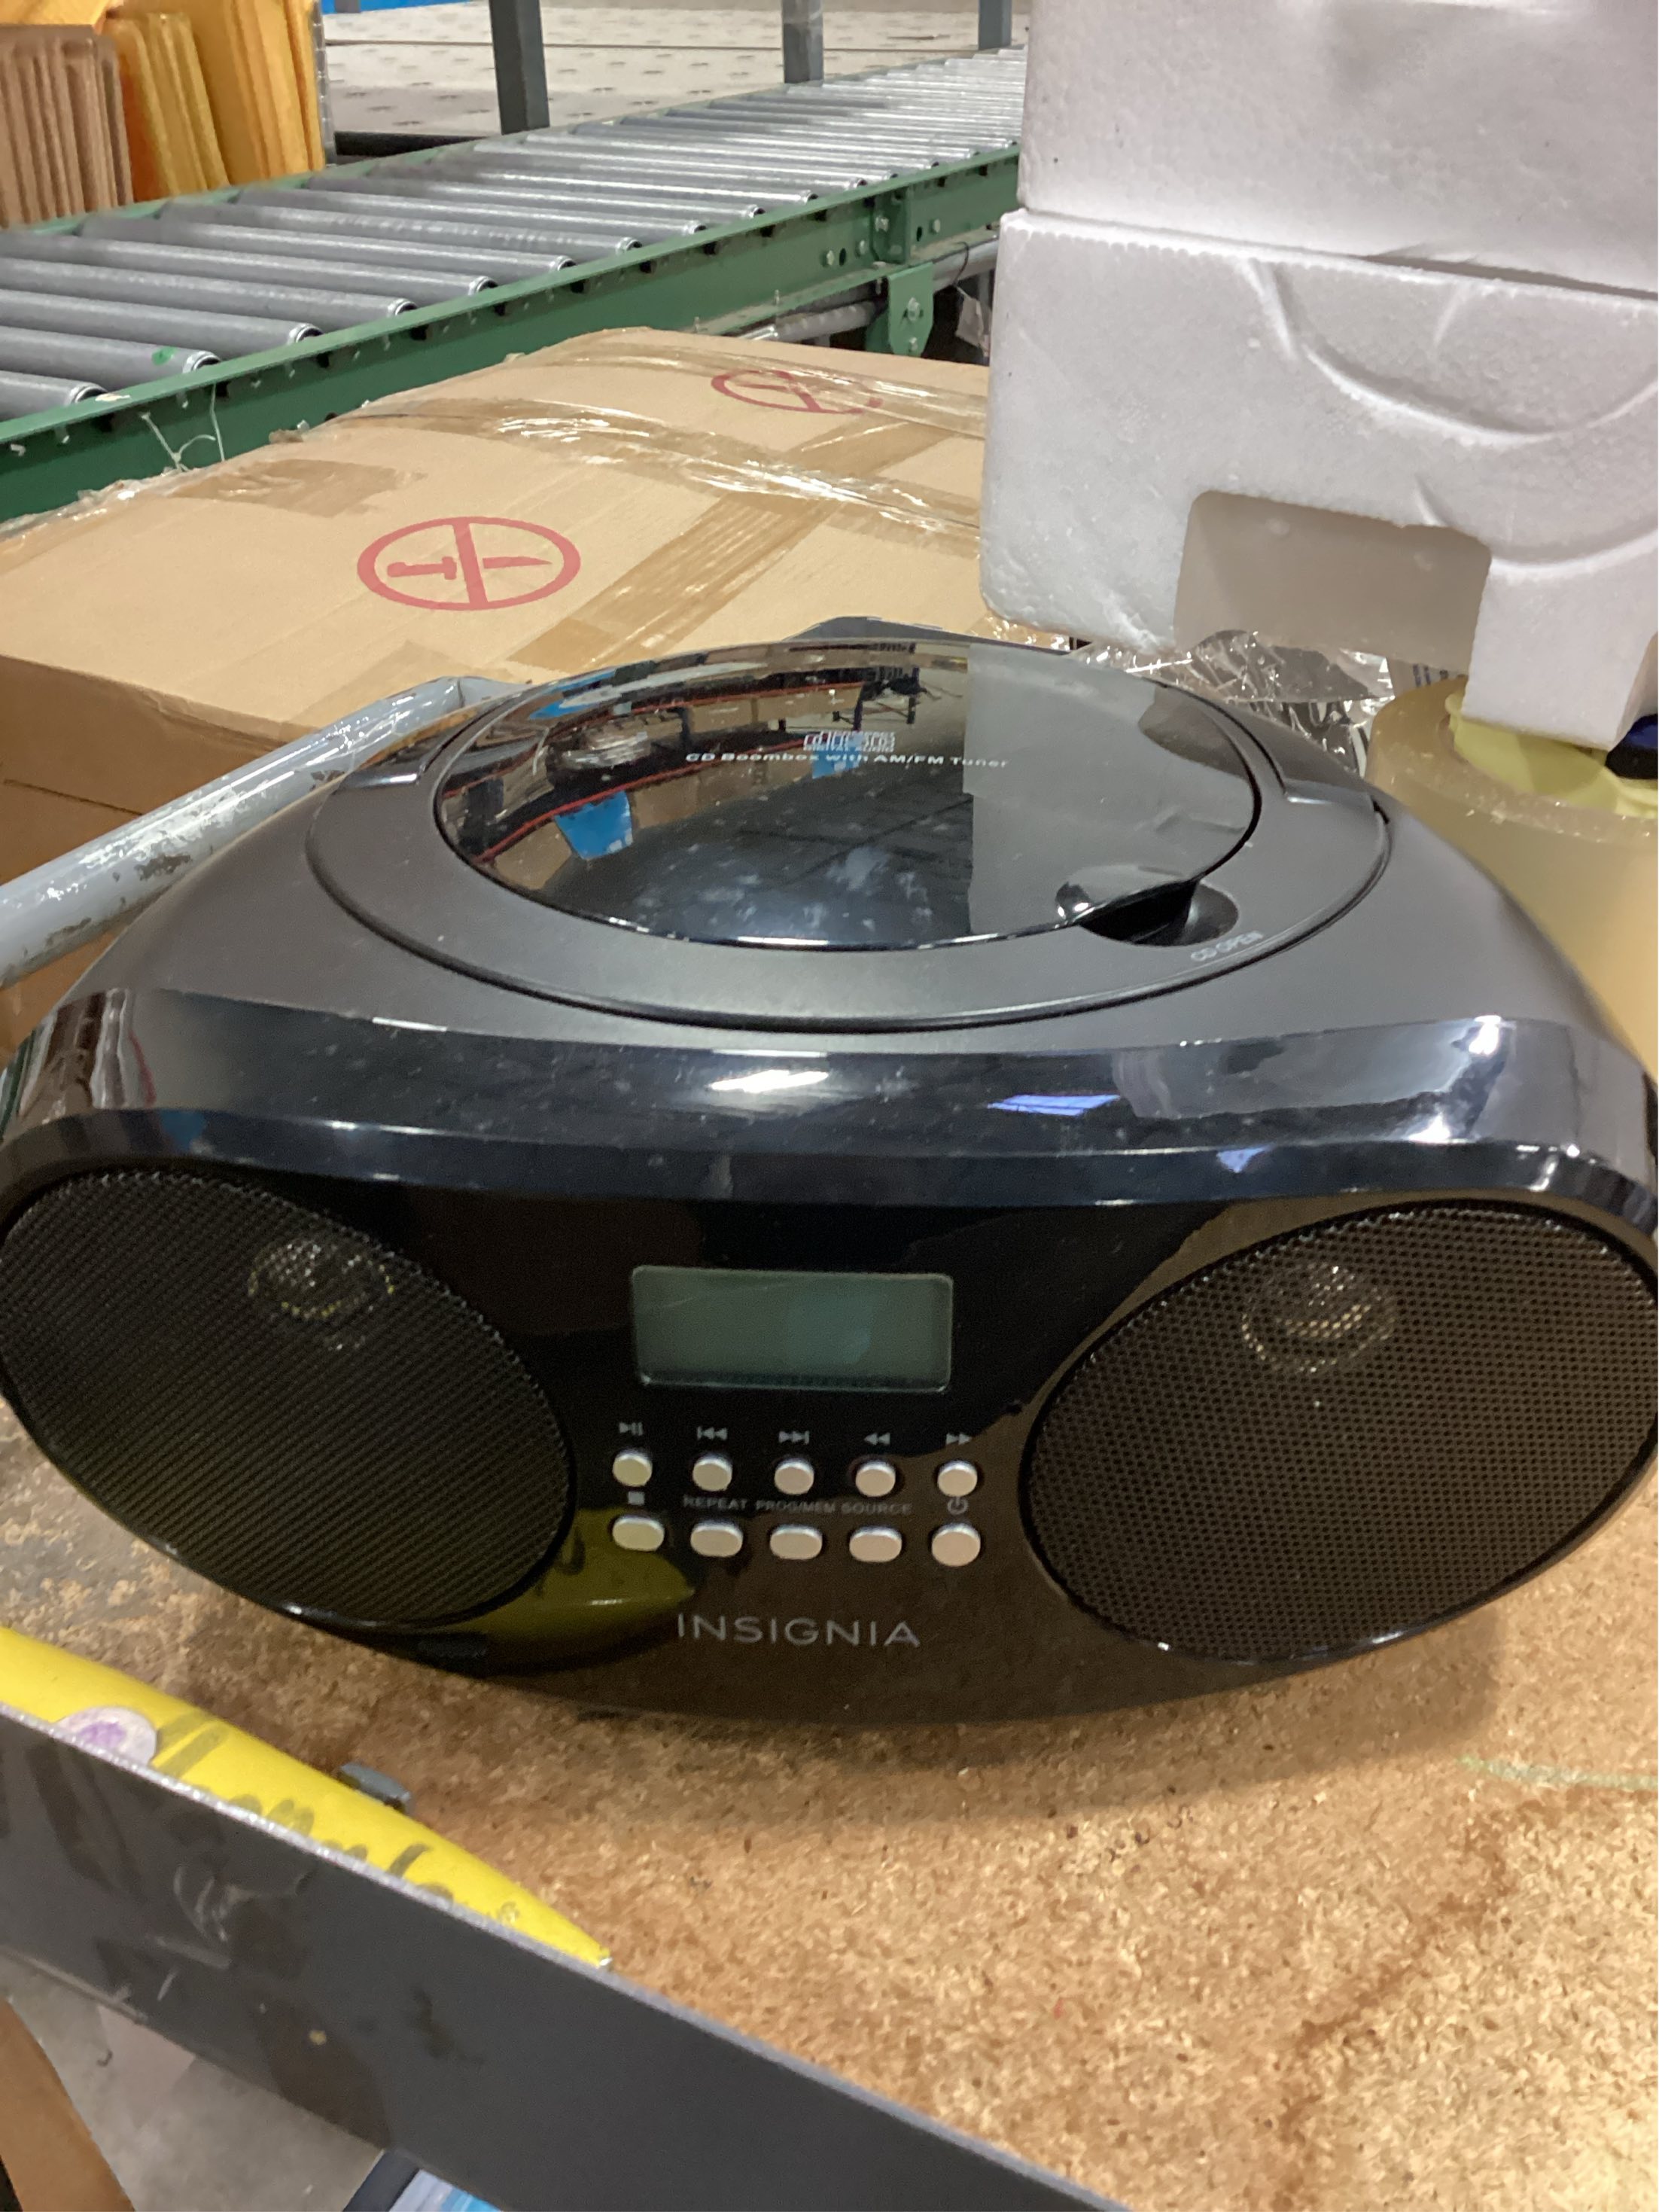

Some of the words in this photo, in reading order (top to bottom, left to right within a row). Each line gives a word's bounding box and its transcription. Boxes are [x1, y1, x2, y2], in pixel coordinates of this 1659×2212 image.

[686, 753, 715, 762] CD
[721, 753, 819, 761] Boombox
[826, 754, 869, 762] with
[873, 754, 945, 764] AM/FM
[950, 757, 1009, 768] Tuner
[683, 1494, 747, 1510] REPEAT
[841, 1502, 912, 1515] SOURCE
[678, 1613, 921, 1647] INSIGNIA
